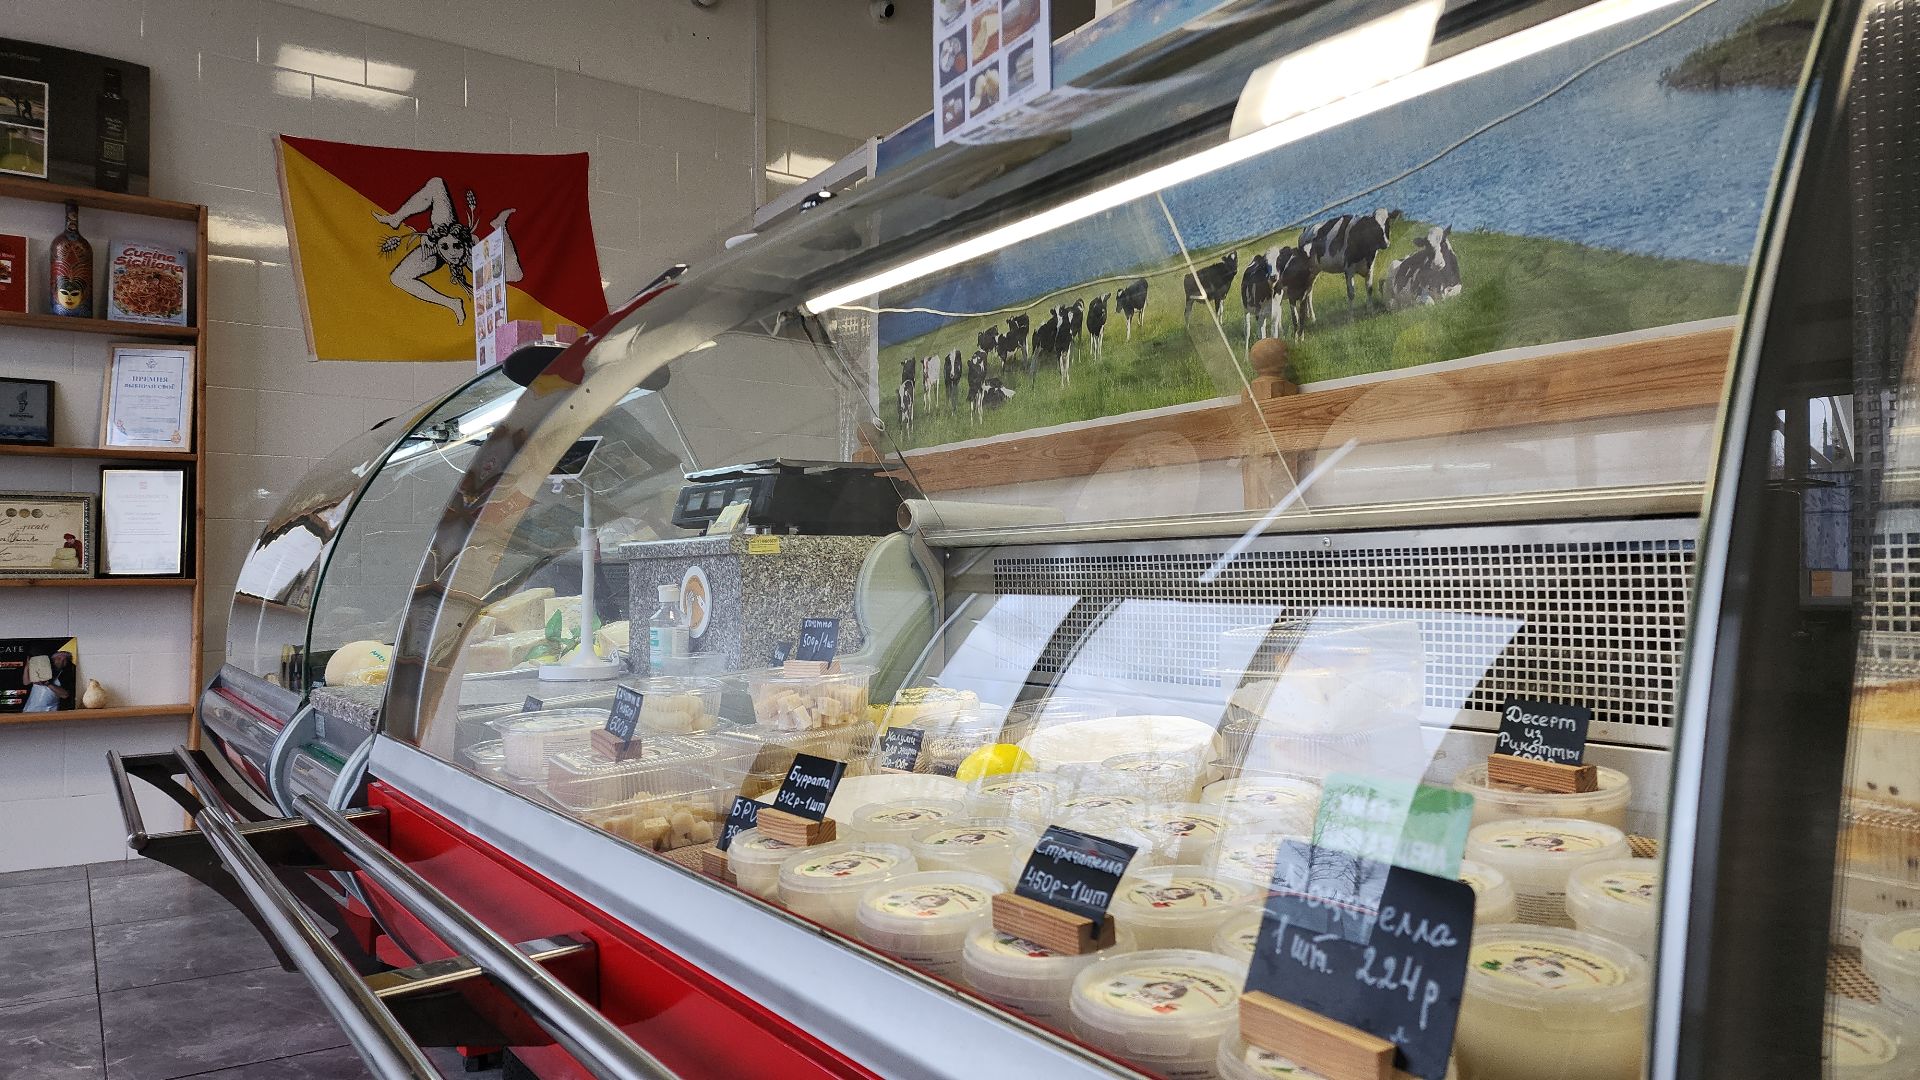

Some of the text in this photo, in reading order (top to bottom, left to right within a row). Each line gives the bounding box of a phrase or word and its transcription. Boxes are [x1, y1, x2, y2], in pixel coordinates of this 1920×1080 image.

[113, 255, 185, 273] Siciliana
[122, 247, 177, 263] Cucina
[1506, 705, 1577, 732] Десерт
[1497, 731, 1580, 760] Рикотты
[1524, 727, 1543, 747] из
[789, 765, 831, 790] Буррата
[778, 790, 827, 815] 312р-1шт
[1024, 865, 1109, 907] 450р-1шт
[1356, 946, 1440, 1030] 224р
